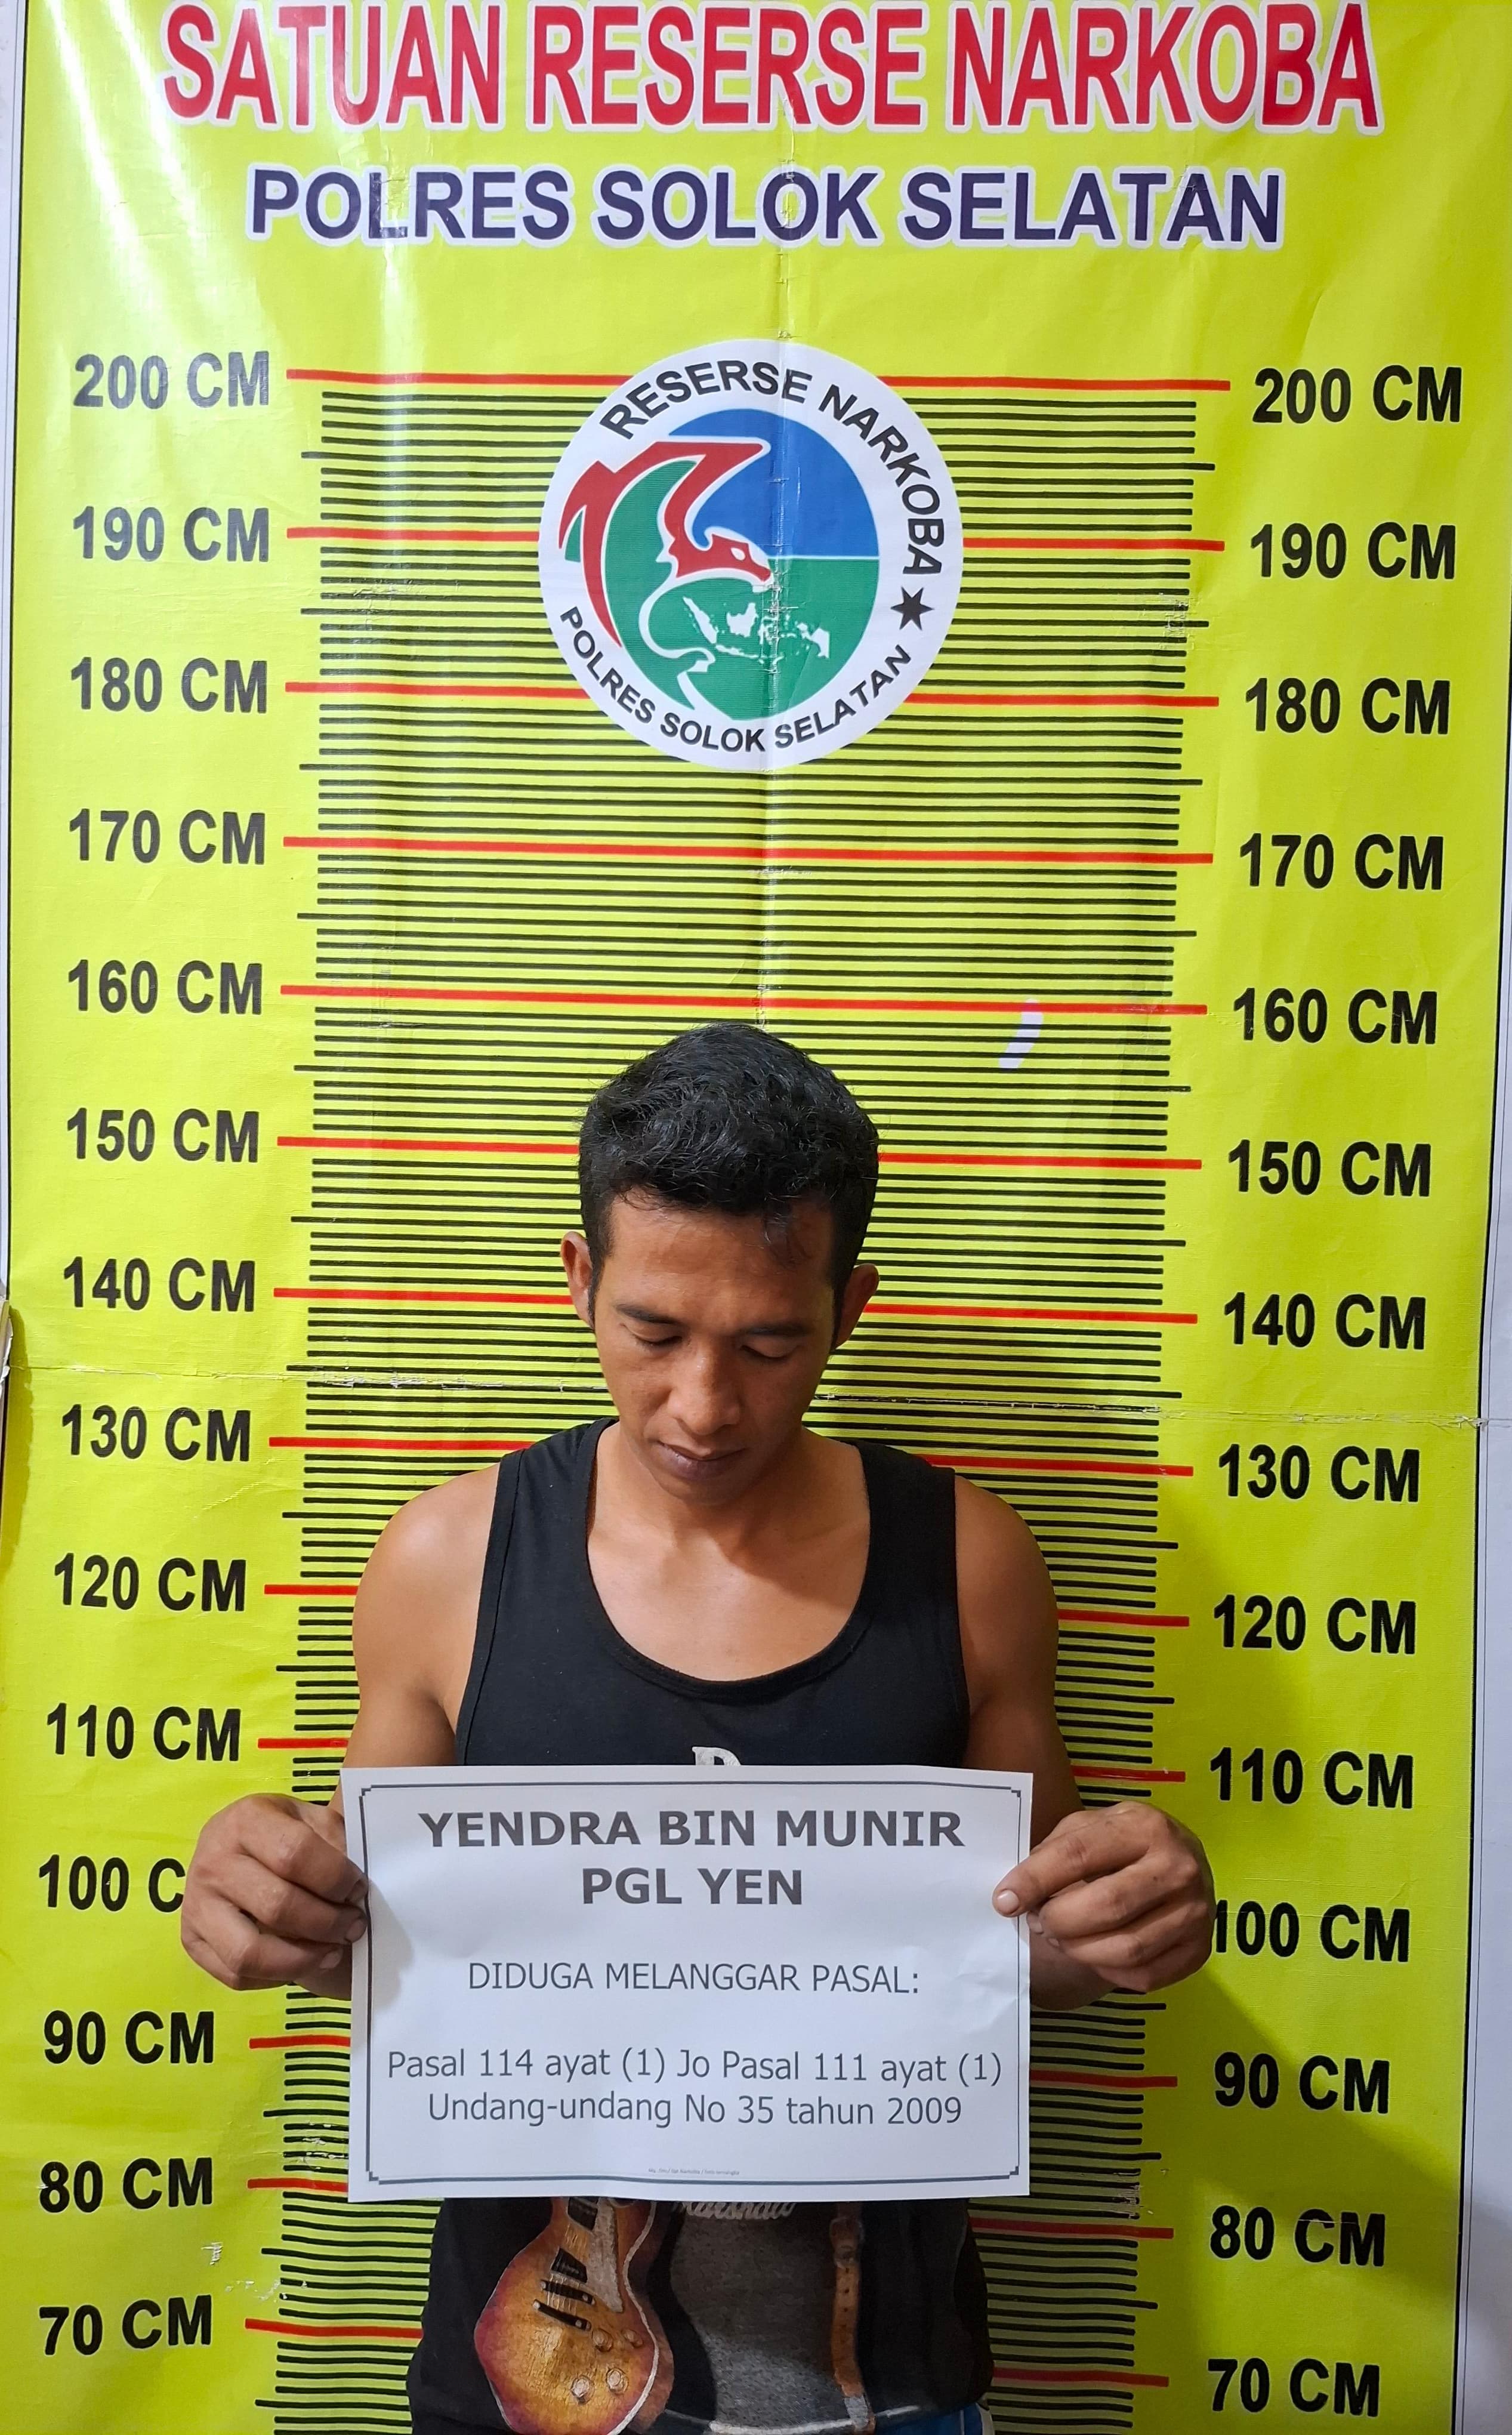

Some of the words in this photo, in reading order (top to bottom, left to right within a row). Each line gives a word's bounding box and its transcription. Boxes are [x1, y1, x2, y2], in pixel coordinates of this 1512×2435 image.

[165, 6, 499, 125] SATUAN
[533, 7, 922, 125] RESERSE
[952, 4, 1377, 127] NARKOBA
[254, 169, 569, 239] POLRES
[598, 171, 877, 241] SOLOK
[905, 172, 1279, 242] SELATAN
[74, 355, 168, 409] 200
[186, 351, 270, 407] CM
[1252, 368, 1351, 423] 200
[1373, 365, 1461, 422] CM
[598, 359, 812, 439] RESERSE
[818, 384, 945, 575] NARKOBA
[74, 506, 163, 560] 190
[184, 507, 268, 562] CM
[1251, 523, 1347, 578] 190
[1368, 522, 1455, 579] CM
[72, 657, 162, 711] 180
[182, 658, 267, 713] CM
[560, 606, 656, 723] POLRES
[660, 710, 766, 752] SOLOK
[774, 645, 912, 750] SELATAN
[1246, 678, 1340, 733] 180
[1362, 678, 1450, 734] CM
[70, 809, 160, 863] 170
[180, 810, 265, 864] CM
[1241, 833, 1334, 889] 170
[1355, 834, 1443, 890] CM
[69, 960, 158, 1013] 160
[178, 960, 262, 1015] CM
[1234, 988, 1327, 1043] 160
[1349, 989, 1437, 1044] CM
[67, 1108, 155, 1161] 150
[174, 1109, 258, 1163] CM
[1229, 1139, 1320, 1195] 150
[1341, 1142, 1431, 1197] CM
[64, 1257, 150, 1310] 140
[169, 1258, 255, 1312] CM
[1224, 1292, 1314, 1347] 140
[1336, 1294, 1425, 1349] CM
[63, 1404, 146, 1459] 130
[165, 1407, 251, 1462] CM
[1219, 1444, 1310, 1499] 130
[1331, 1446, 1420, 1502] CM
[55, 1553, 138, 1610] 120
[159, 1558, 246, 1611] CM
[1214, 1595, 1306, 1650] 120
[1327, 1598, 1416, 1654] CM
[47, 1703, 134, 1759] 110
[154, 1707, 240, 1761] CM
[1210, 1747, 1303, 1804] 110
[1323, 1751, 1413, 1809] CM
[418, 1811, 641, 1847] YENDRA
[659, 1810, 754, 1846] BIN
[777, 1810, 965, 1847] MUNIR
[39, 1854, 129, 1912] 100
[149, 1858, 186, 1913] C
[583, 1867, 682, 1904] PGL
[697, 1868, 802, 1905] YEN
[1216, 1900, 1299, 1957] 100
[1320, 1904, 1409, 1962] CM
[470, 1962, 593, 1989] DIDUGA
[606, 1963, 800, 1991] MELANGGAR
[813, 1965, 918, 1993] PASAL:
[44, 2010, 106, 2064] 90
[125, 2011, 214, 2064] CM
[389, 2048, 464, 2078] Pasal
[481, 2049, 533, 2076] 114
[546, 2049, 610, 2083] ayat
[623, 2047, 664, 2083] (1)
[677, 2049, 709, 2078] Jo
[724, 2051, 798, 2080] Pasal
[815, 2053, 866, 2080] 111
[881, 2055, 946, 2088] ayat
[959, 2052, 1001, 2087] (1)
[1215, 2052, 1279, 2109] 90
[1299, 2055, 1389, 2114] CM
[430, 2091, 670, 2128] Undang-undang
[686, 2094, 725, 2123] No
[738, 2095, 773, 2123] 35
[786, 2096, 873, 2125] tahun
[888, 2097, 961, 2124] 2009
[40, 2161, 103, 2212] 80
[123, 2157, 212, 2209] CM
[1210, 2205, 1274, 2260] 80
[1295, 2209, 1386, 2267] CM
[39, 2305, 103, 2355] 70
[122, 2295, 211, 2348] CM
[1208, 2358, 1270, 2412] 70
[1290, 2359, 1380, 2417] CM
